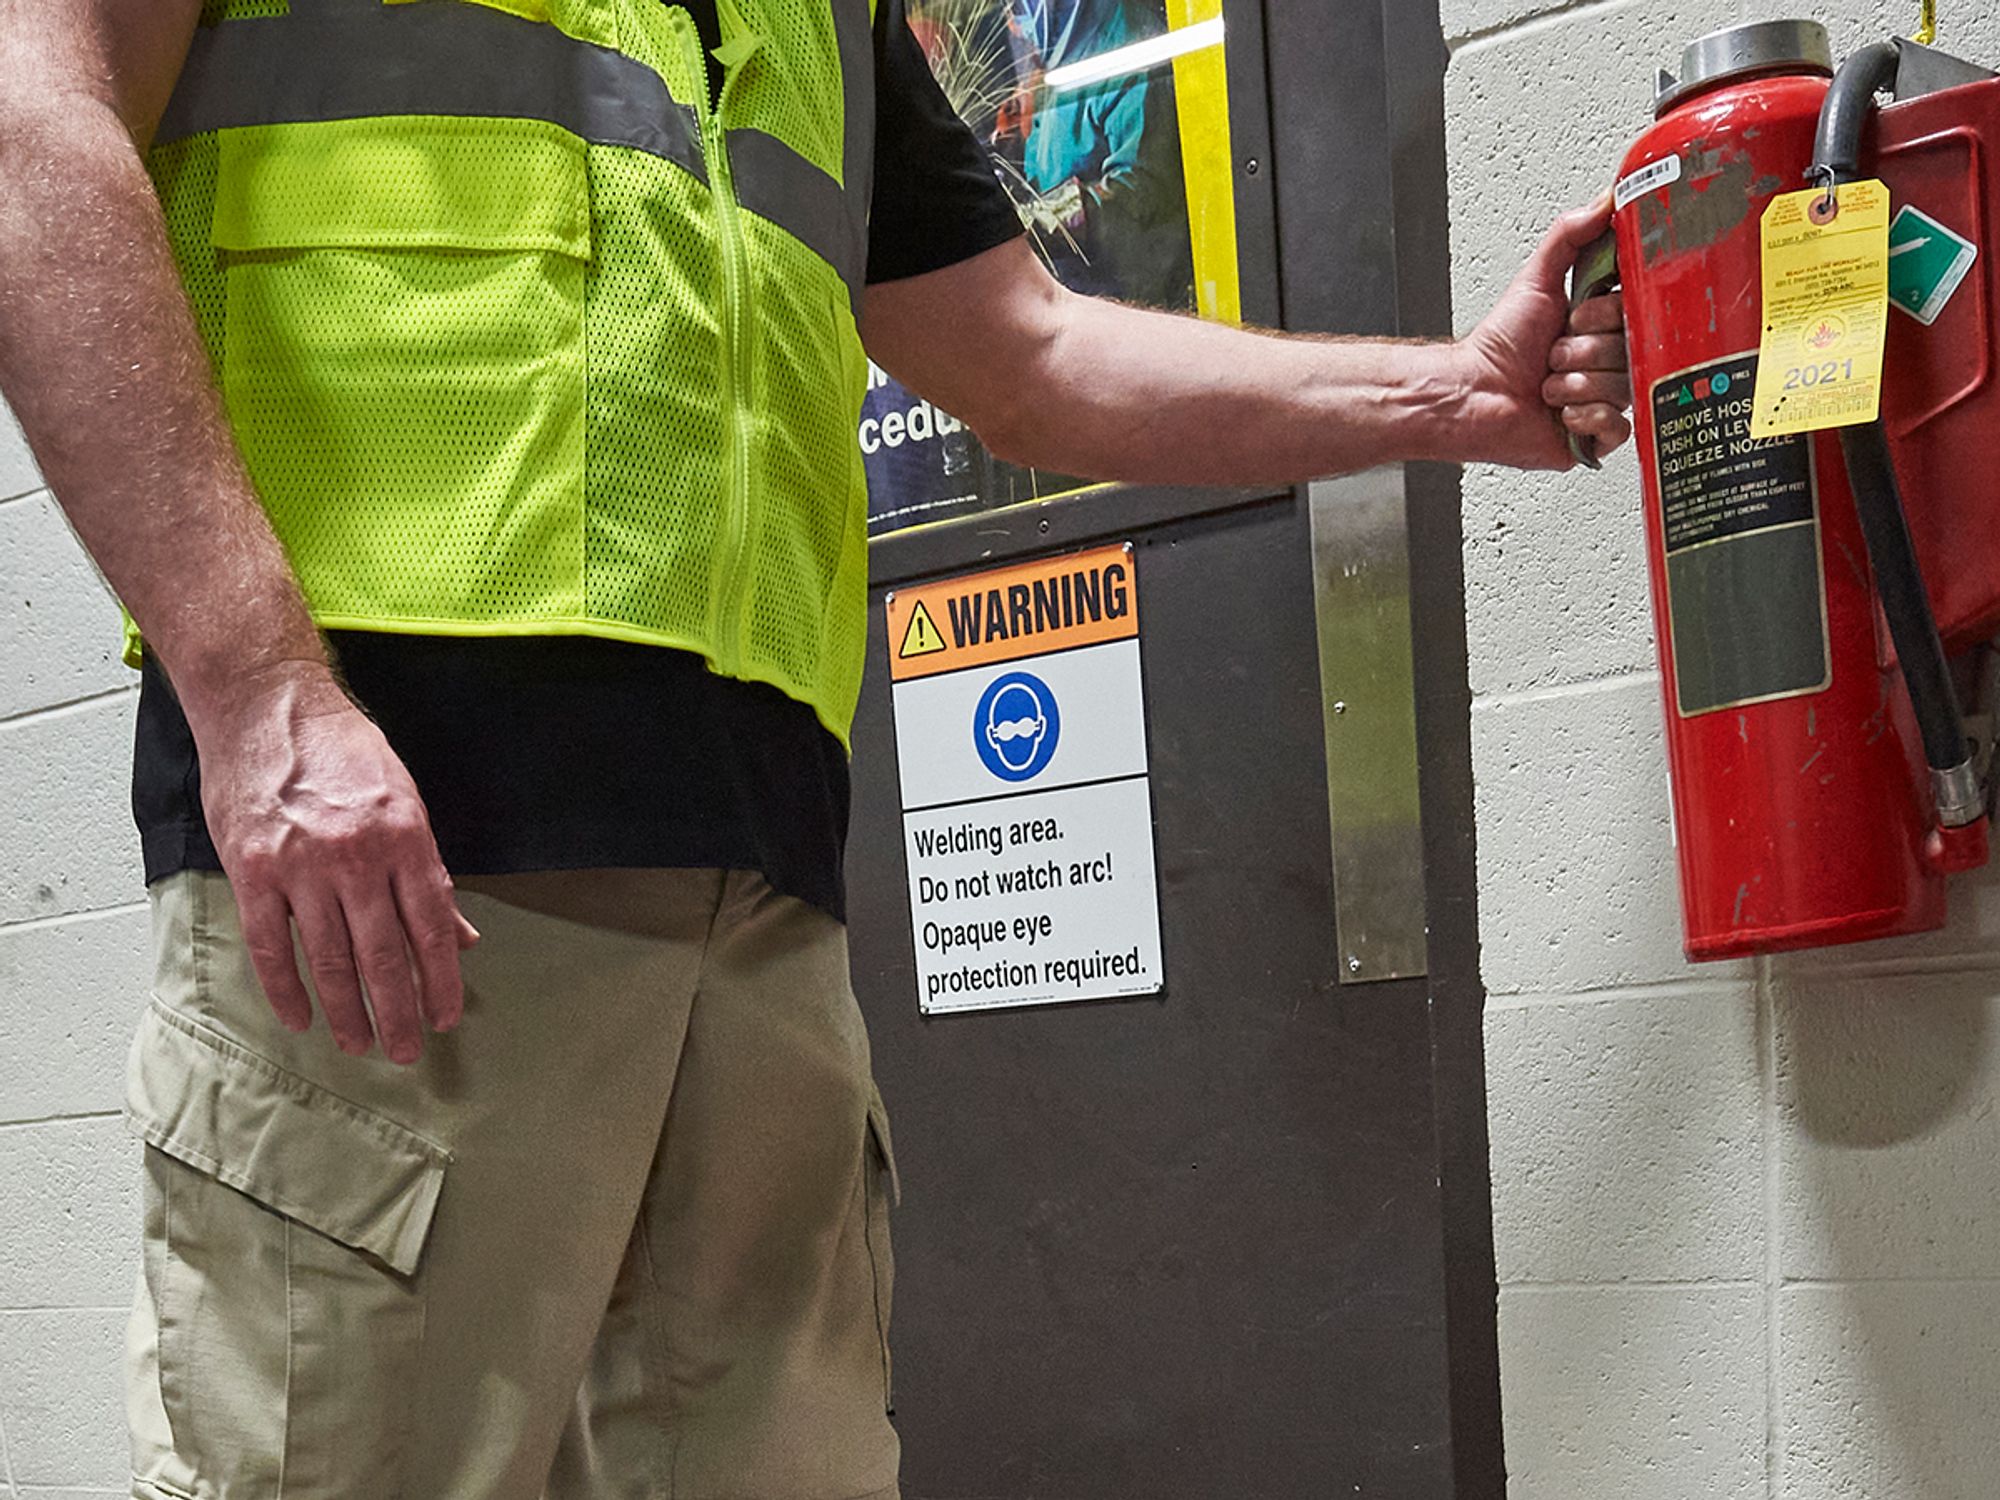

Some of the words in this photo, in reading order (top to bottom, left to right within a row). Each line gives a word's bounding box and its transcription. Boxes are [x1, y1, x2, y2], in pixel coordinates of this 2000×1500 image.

[1783, 358, 1852, 390] 2021
[858, 398, 971, 454] cedu
[1660, 407, 1713, 437] REMOVE
[1718, 398, 1752, 419] HOS
[1661, 434, 1694, 457] PUSH
[1697, 427, 1719, 444] ON
[1663, 445, 1725, 476] SQUEEZE
[1730, 434, 1795, 455] NOZZLE
[948, 563, 1128, 648] WARNING
[914, 823, 1003, 858] Welding
[1009, 818, 1064, 846] area.
[919, 875, 948, 903] Do
[955, 869, 991, 900] not
[996, 860, 1062, 895] watch
[1069, 852, 1113, 884] arc!
[923, 919, 1006, 955] Opaque
[1013, 912, 1052, 945] eye
[927, 960, 1038, 1001] protection
[1045, 946, 1147, 989] required.
